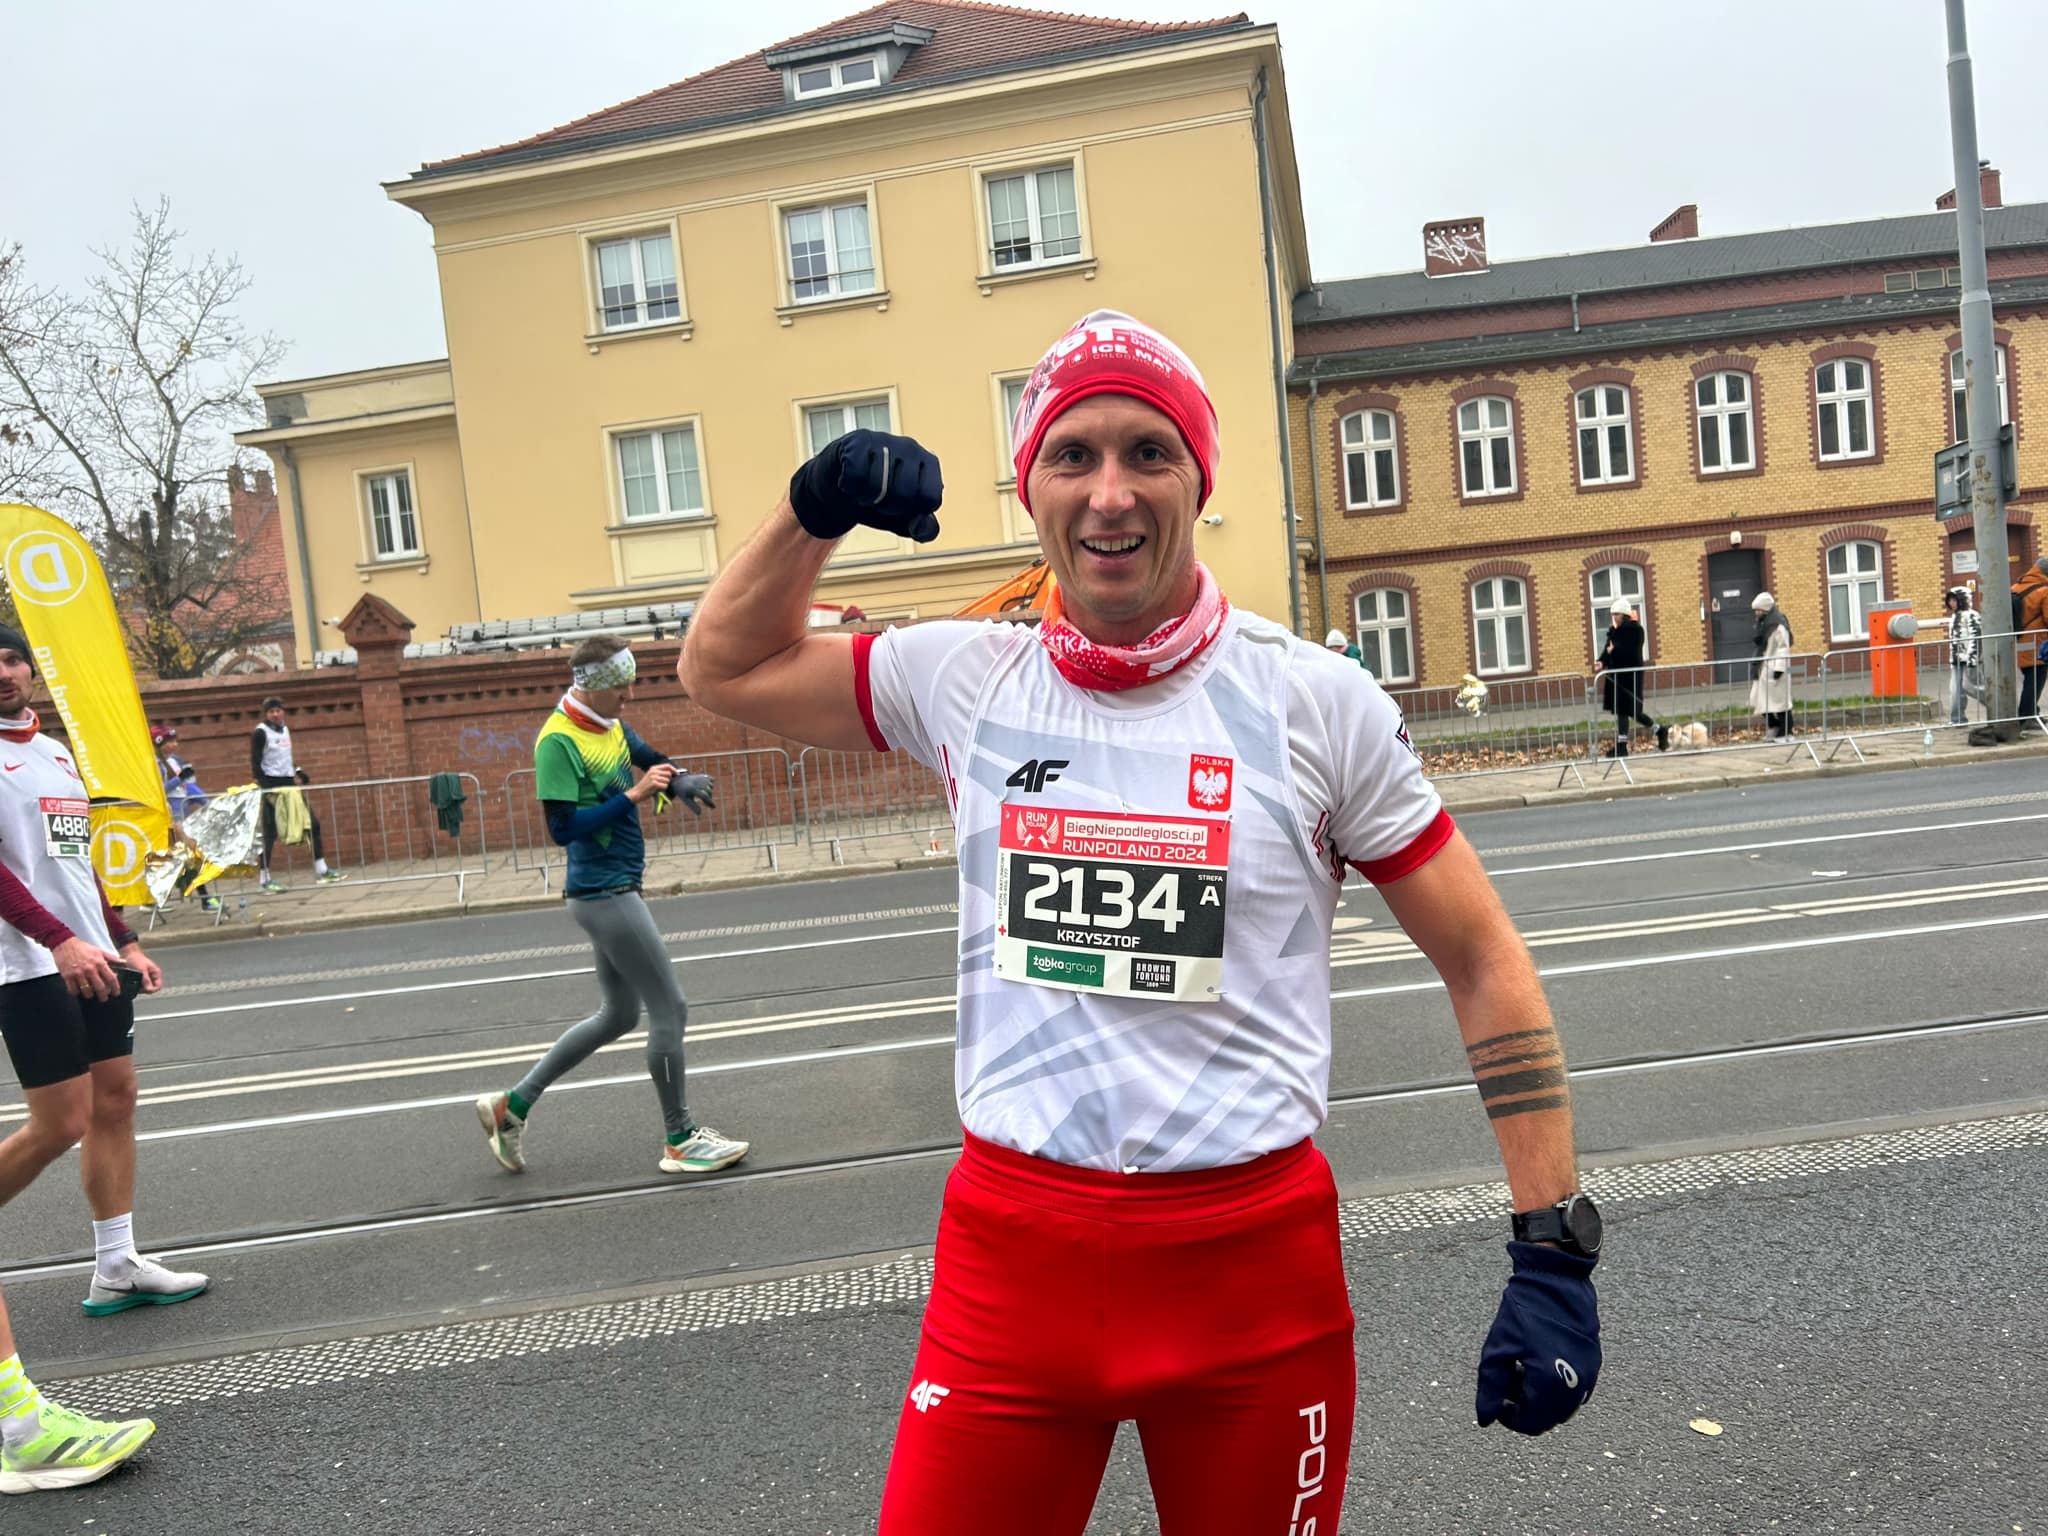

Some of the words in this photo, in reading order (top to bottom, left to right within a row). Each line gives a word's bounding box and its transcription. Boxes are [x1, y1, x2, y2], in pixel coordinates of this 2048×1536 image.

[1091, 343, 1129, 354] ICE
[1135, 348, 1172, 373] MAT
[1193, 757, 1231, 768] POLSKA
[1005, 759, 1070, 793] 4F
[1026, 811, 1048, 822] RUN
[1066, 821, 1206, 843] BiegNiepodleglosci.pl
[103, 833, 137, 876] D
[1062, 839, 1161, 859] RUNPOLAND
[1164, 846, 1208, 862] 2024
[1198, 874, 1224, 883] STREFA
[1024, 863, 1185, 933] 2134
[1199, 885, 1221, 907] A
[1057, 929, 1141, 949] KRZYSZTOF
[1135, 971, 1171, 982] FORTUNA
[1136, 963, 1171, 974] BROWAR
[910, 1379, 950, 1414] 4F
